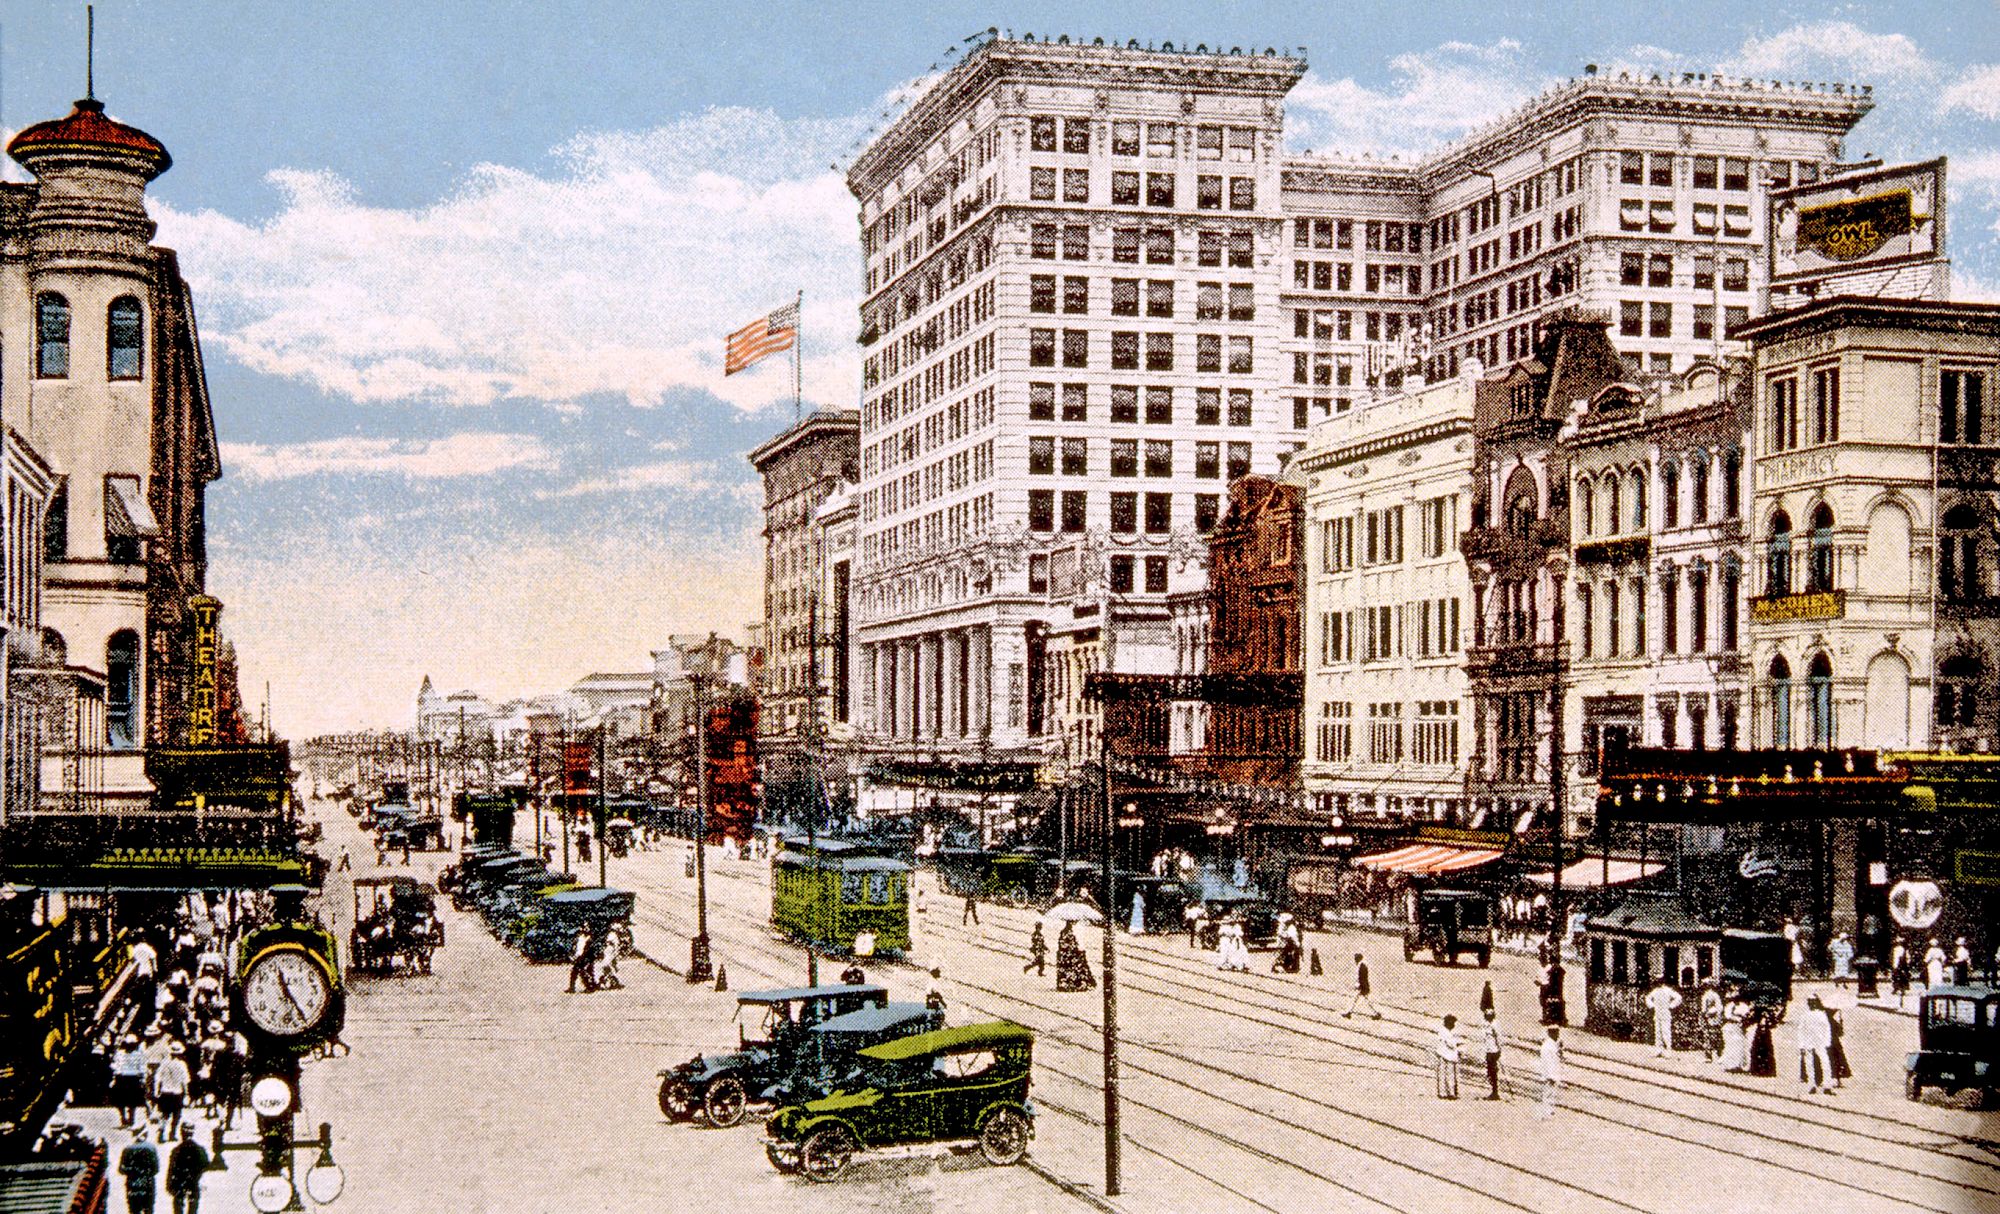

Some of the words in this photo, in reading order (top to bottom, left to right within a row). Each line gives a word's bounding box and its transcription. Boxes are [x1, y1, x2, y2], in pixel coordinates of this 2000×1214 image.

[1826, 220, 1880, 247] OWL
[1763, 452, 1839, 483] PHARMACY
[199, 606, 217, 744] THEATRE
